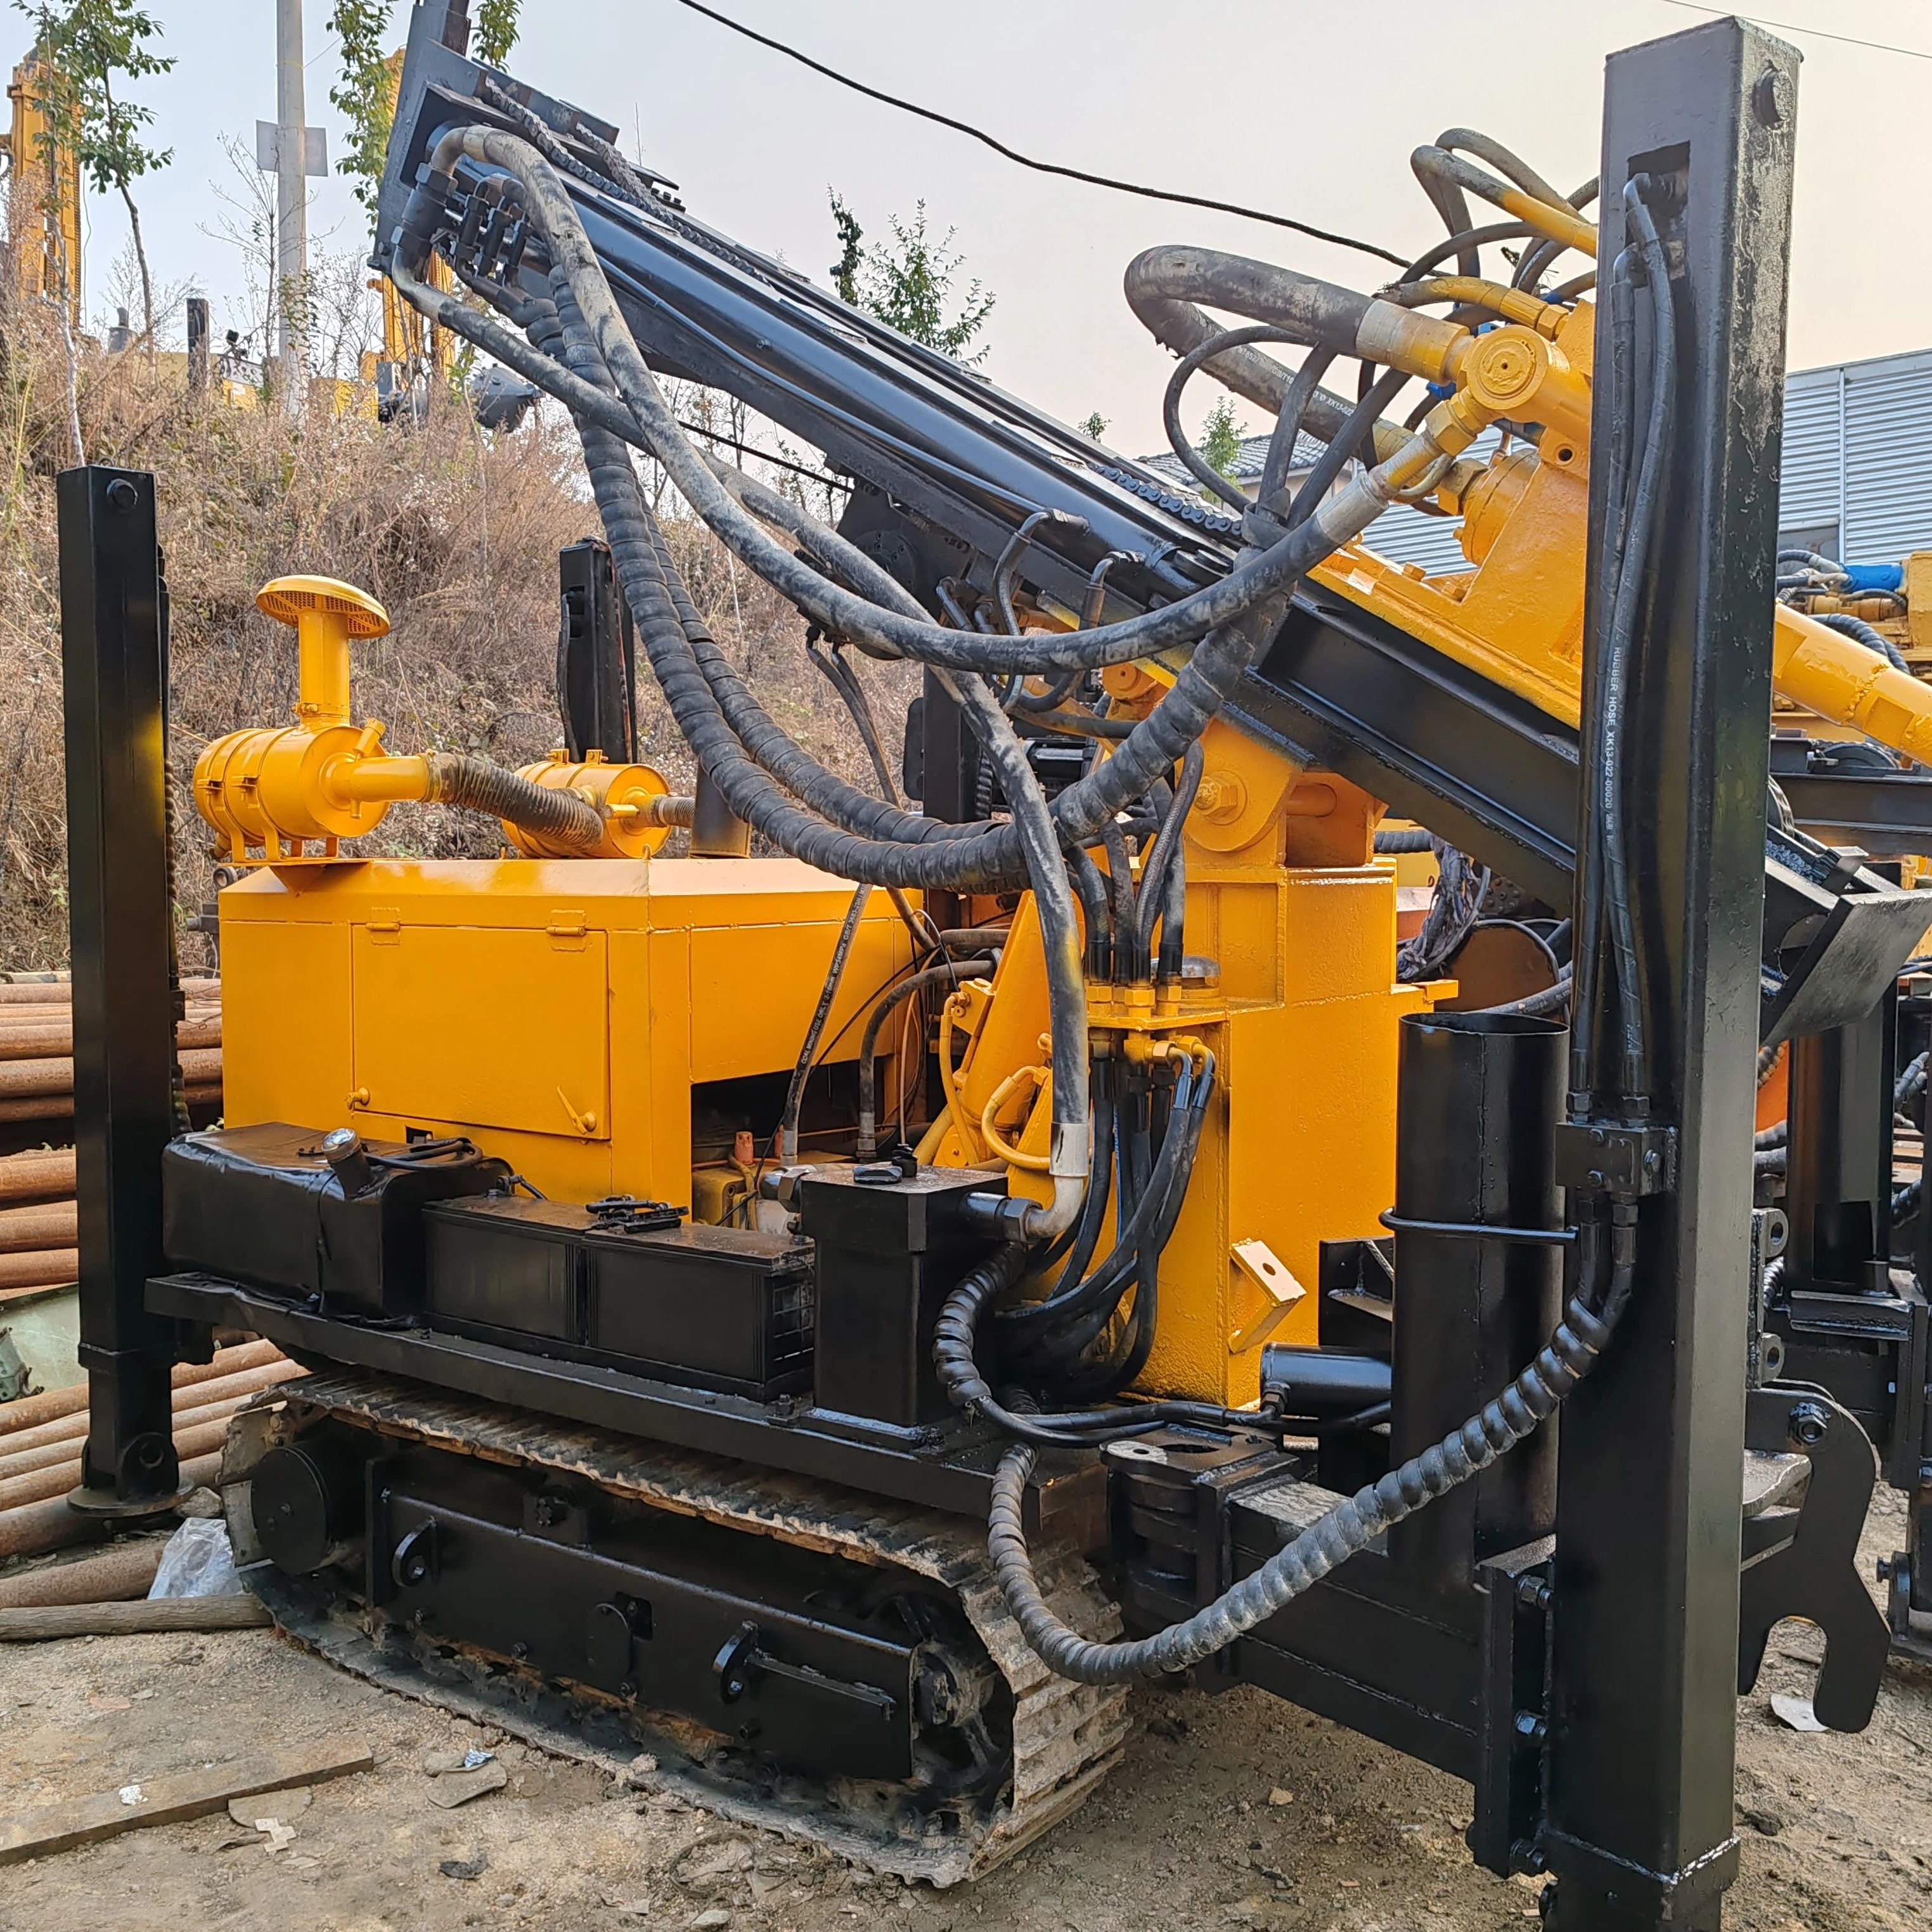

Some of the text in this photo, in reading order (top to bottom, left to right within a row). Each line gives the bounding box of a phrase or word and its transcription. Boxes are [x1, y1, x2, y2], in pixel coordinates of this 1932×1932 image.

[1610, 647, 1622, 692] RUBBER
[1606, 697, 1617, 726] HOSE
[1604, 730, 1616, 809] XK13-022-00020
[801, 1048, 811, 1065] COAL
[806, 1029, 817, 1050] MINING
[813, 1019, 822, 1031] USE
[818, 1001, 829, 1019] ONLY
[843, 925, 853, 941] GB/T
